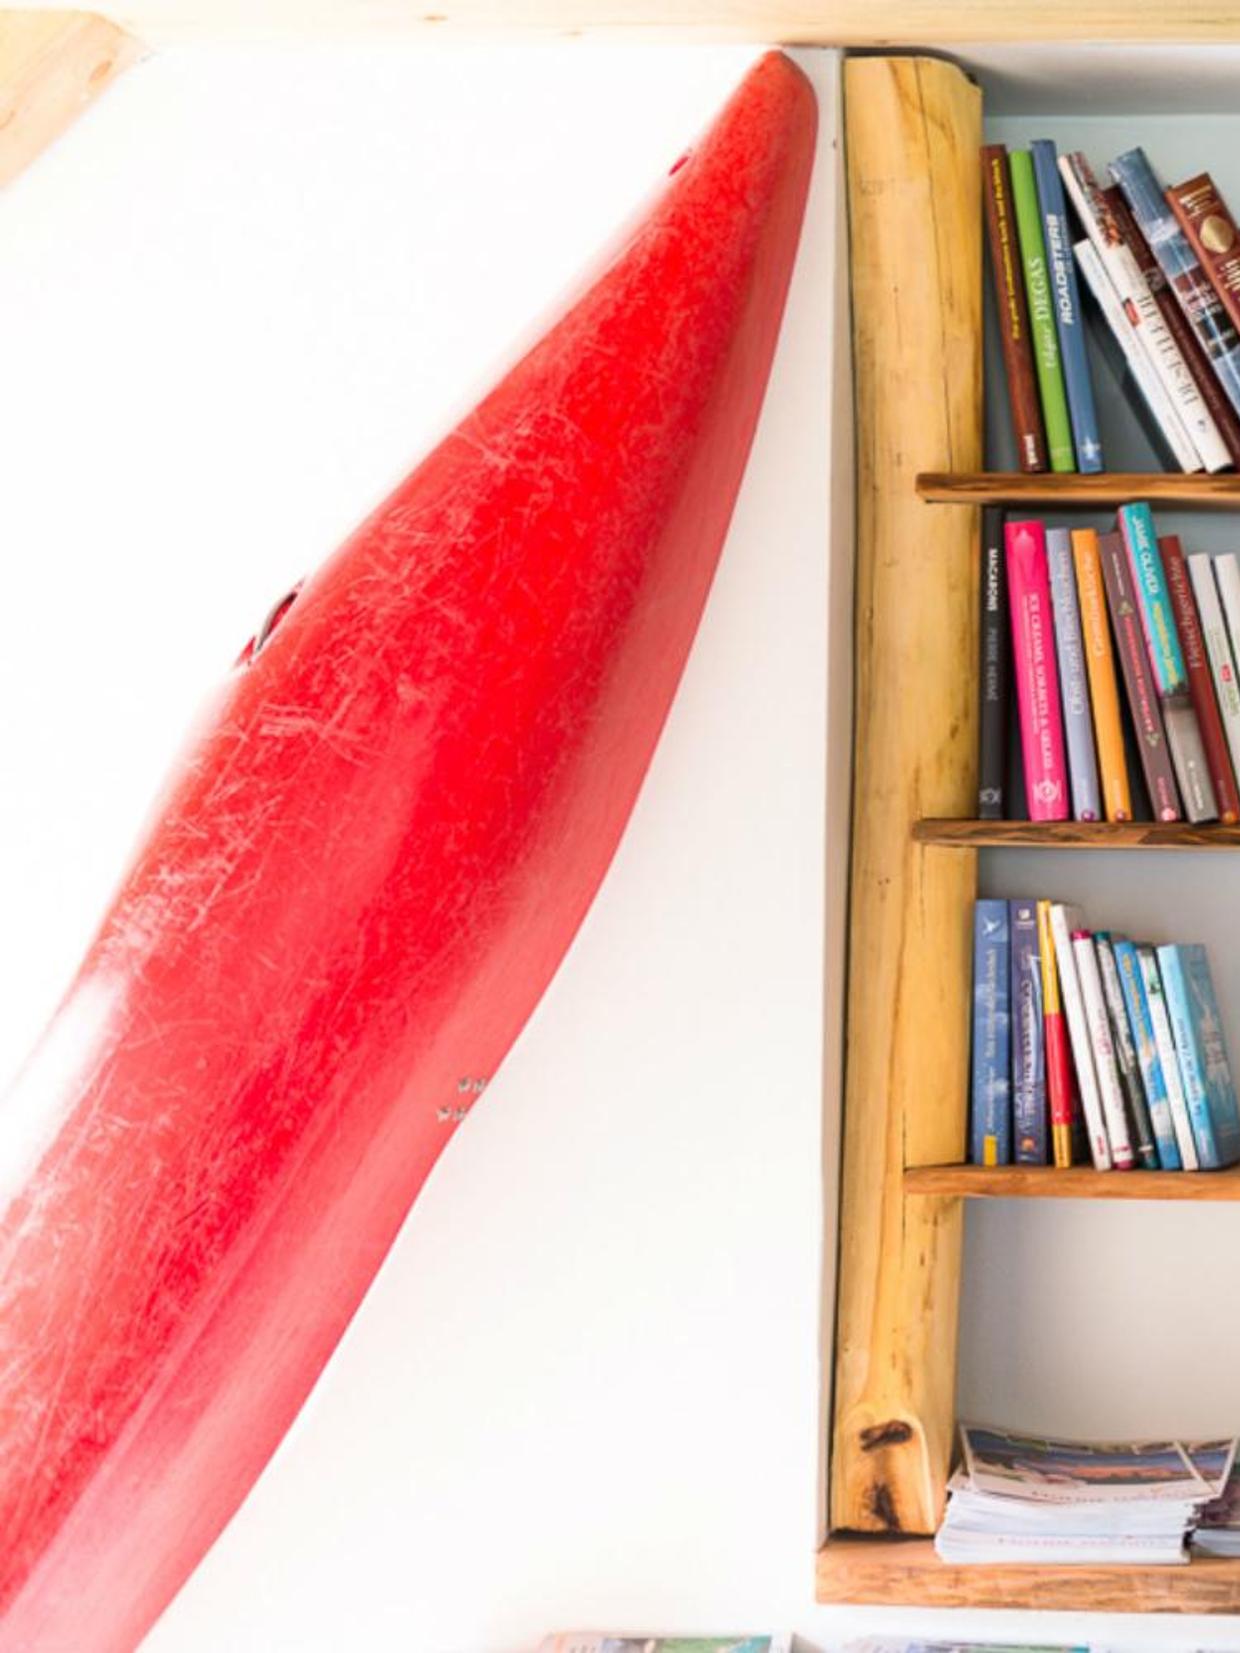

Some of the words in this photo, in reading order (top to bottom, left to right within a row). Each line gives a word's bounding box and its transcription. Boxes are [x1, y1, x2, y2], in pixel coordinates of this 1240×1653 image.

[1027, 255, 1051, 320] DEGAS
[1045, 212, 1074, 325] ROADSTERS
[986, 548, 998, 611] MACARONS
